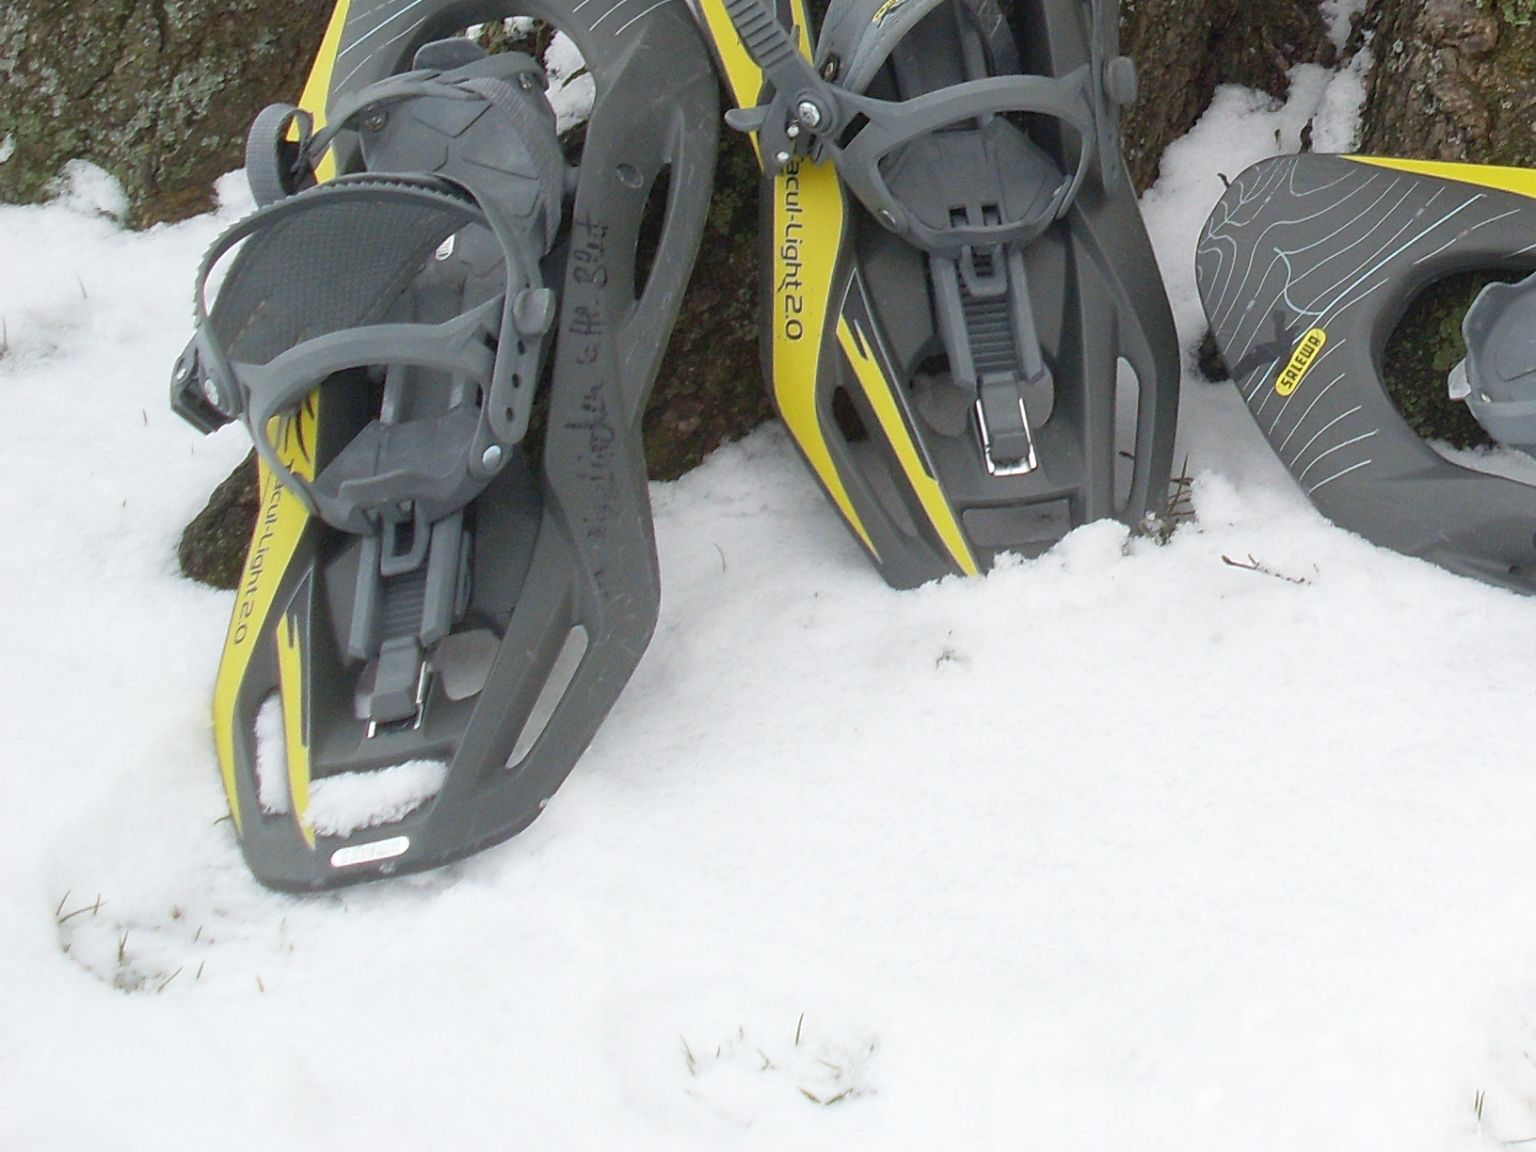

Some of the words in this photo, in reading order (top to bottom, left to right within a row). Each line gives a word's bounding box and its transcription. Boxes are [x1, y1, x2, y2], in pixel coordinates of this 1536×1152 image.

[781, 155, 803, 289] acul-Light
[785, 294, 804, 341] 2.0
[1280, 335, 1321, 389] SALEWA
[234, 601, 254, 645] 2.0
